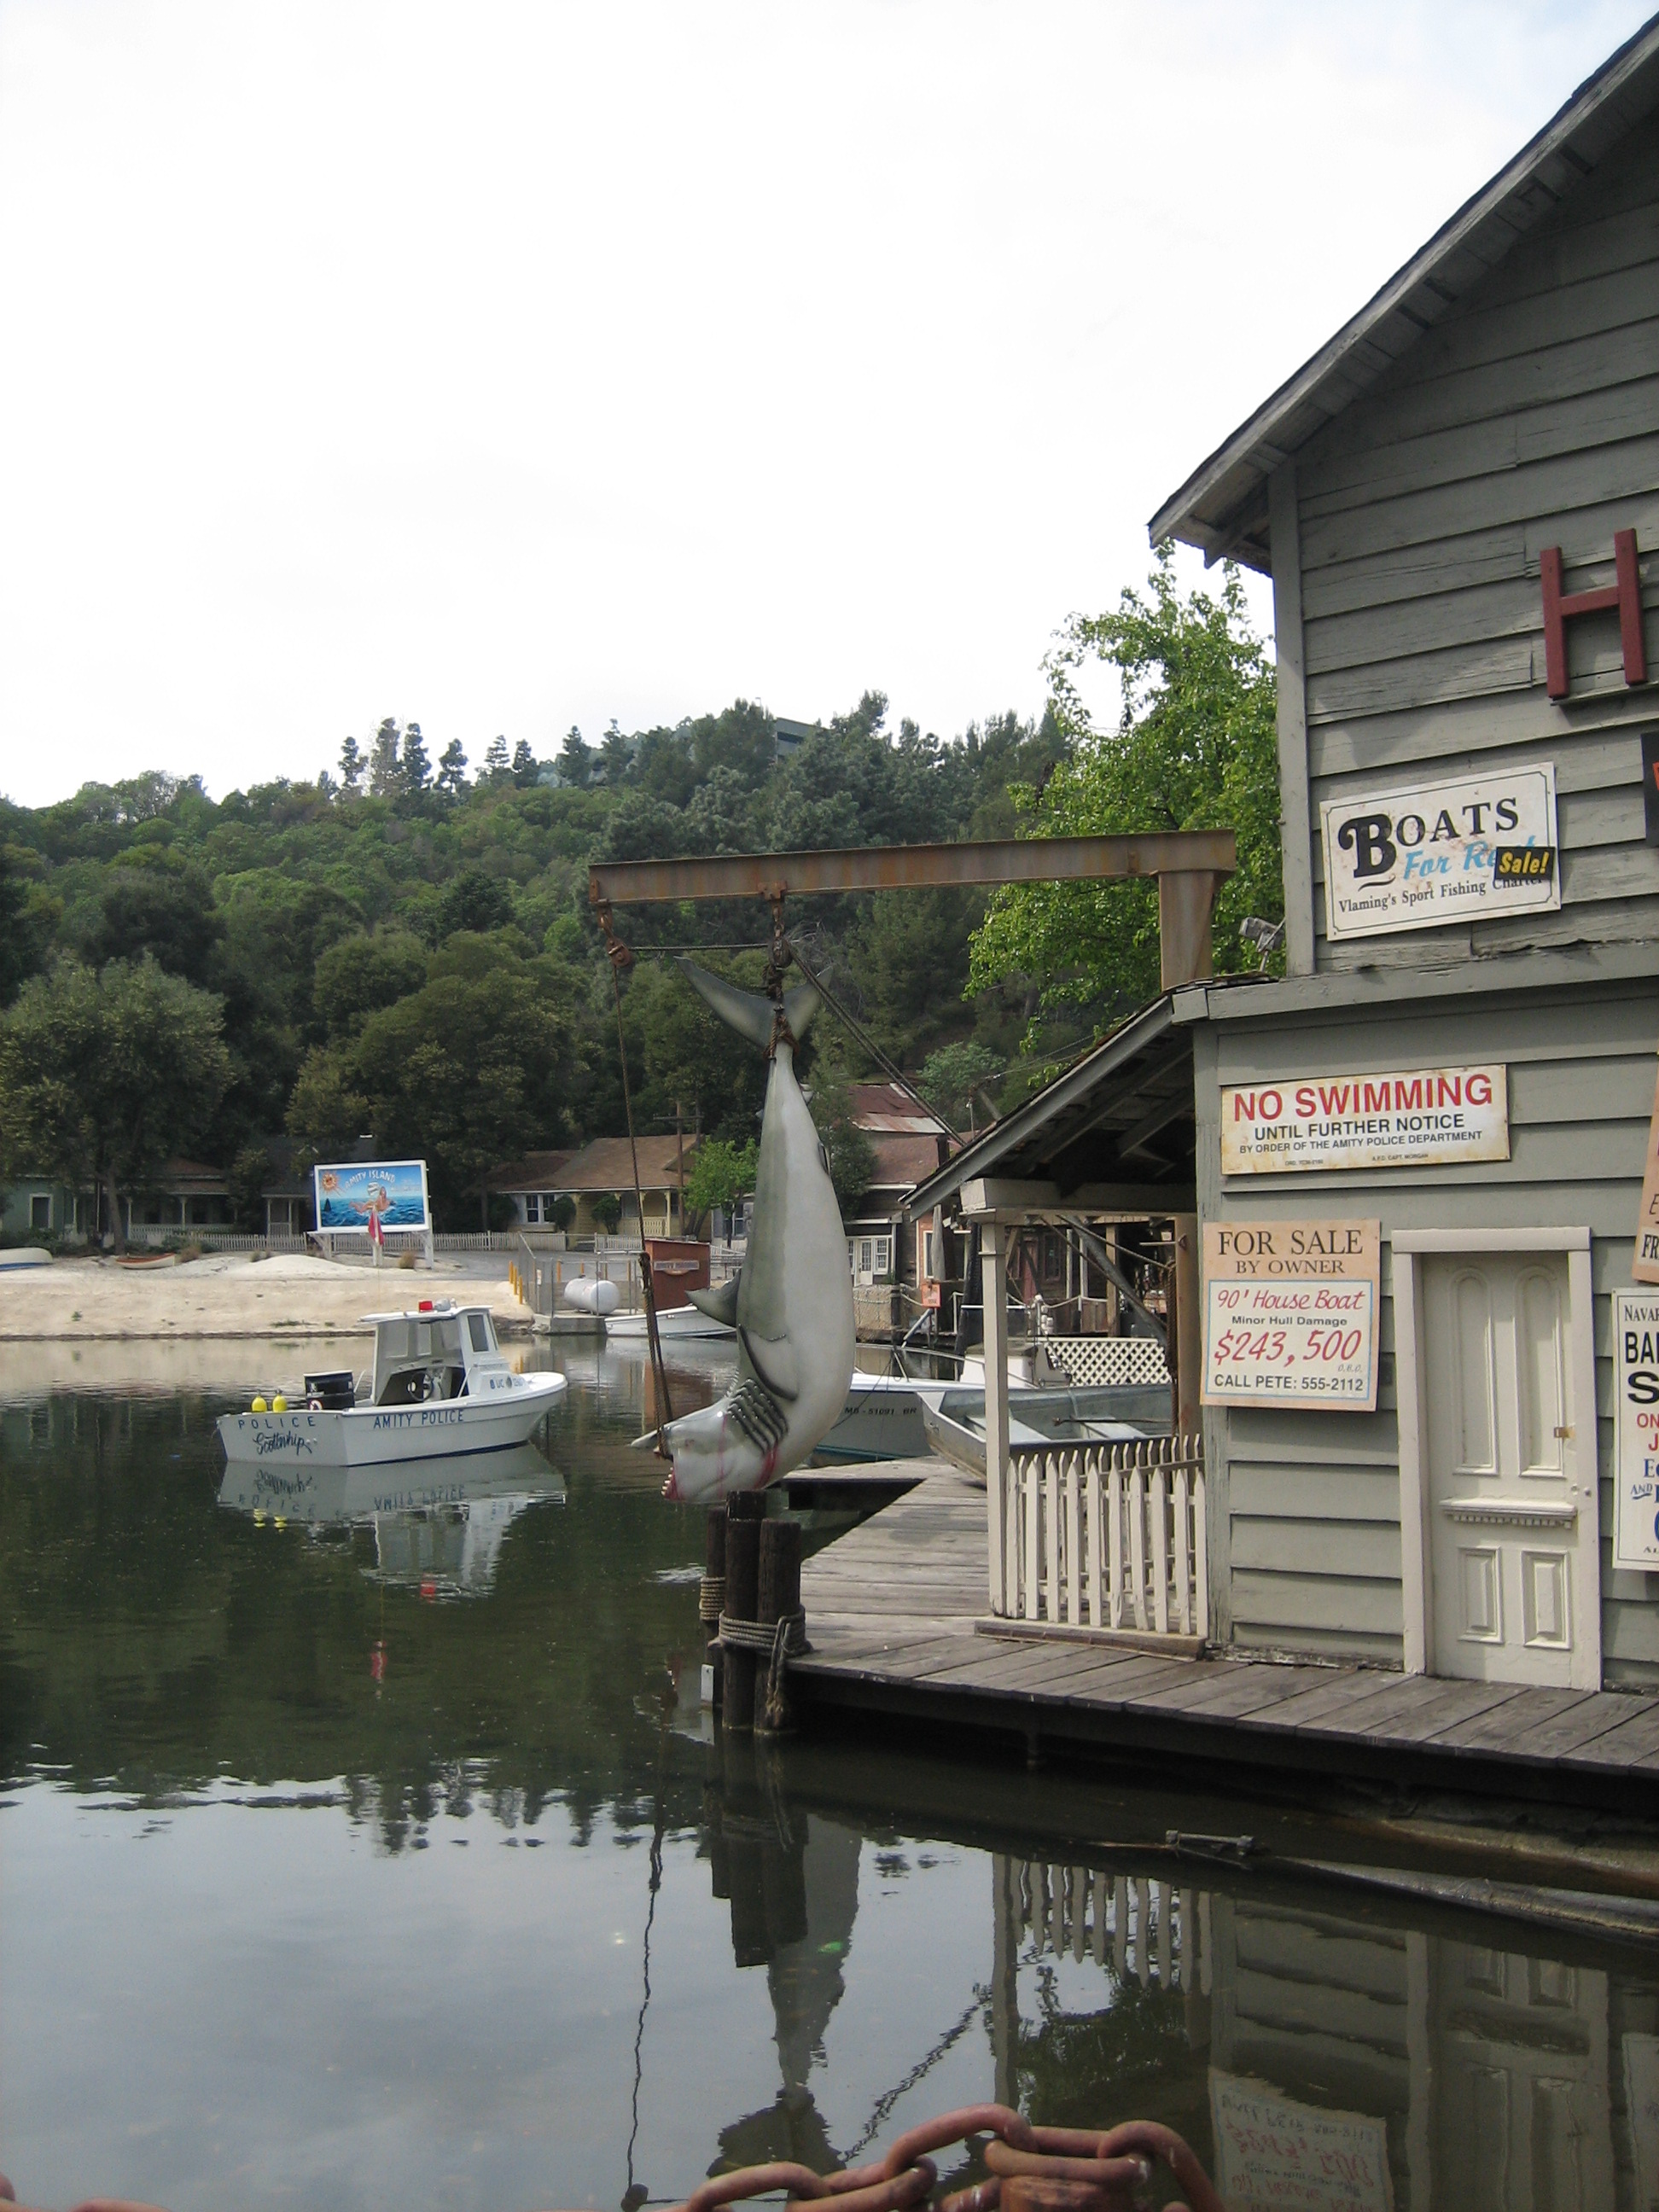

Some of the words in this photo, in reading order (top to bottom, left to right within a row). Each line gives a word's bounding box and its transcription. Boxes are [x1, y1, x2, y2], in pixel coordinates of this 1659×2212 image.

[1337, 797, 1519, 878] BOATS
[1402, 849, 1452, 880] For
[1499, 851, 1549, 874] Sale!
[1339, 894, 1397, 912] Vlaming's
[1401, 888, 1435, 905] Sport
[1441, 880, 1487, 899] Fishing
[1234, 1090, 1283, 1121] NO
[1295, 1074, 1493, 1118] SWIMMING
[1254, 1125, 1303, 1140] UNTIL
[1308, 1119, 1390, 1137] FURTHER
[1396, 1114, 1464, 1132] NOTICE
[1239, 1144, 1253, 1154] BY
[1255, 1142, 1290, 1152] ORDER
[1293, 1141, 1308, 1150] OF
[1310, 1140, 1330, 1150] THE
[1332, 1138, 1363, 1149] AMITY
[1366, 1136, 1406, 1146] POLICE
[1408, 1130, 1483, 1144] DEPARTMENT
[345, 1171, 367, 1189] AMITY
[369, 1170, 396, 1184] ISLAND
[1218, 1231, 1277, 1255] FOR
[1290, 1229, 1363, 1255] SALE
[1236, 1260, 1260, 1274] BY
[1268, 1260, 1345, 1274] OWNER
[1217, 1289, 1249, 1308] 90'
[1253, 1289, 1311, 1310] House
[1314, 1289, 1365, 1310] Boat
[1231, 1315, 1266, 1324] Minor
[1269, 1316, 1293, 1325] Hull
[1296, 1317, 1348, 1328] Damage
[1214, 1374, 1251, 1388] CALL
[1255, 1376, 1297, 1389] PETE:
[1301, 1377, 1364, 1391] 555-2112
[238, 1417, 316, 1430] POLICE
[374, 1413, 412, 1429] AMITY
[422, 1409, 463, 1425] POLICE
